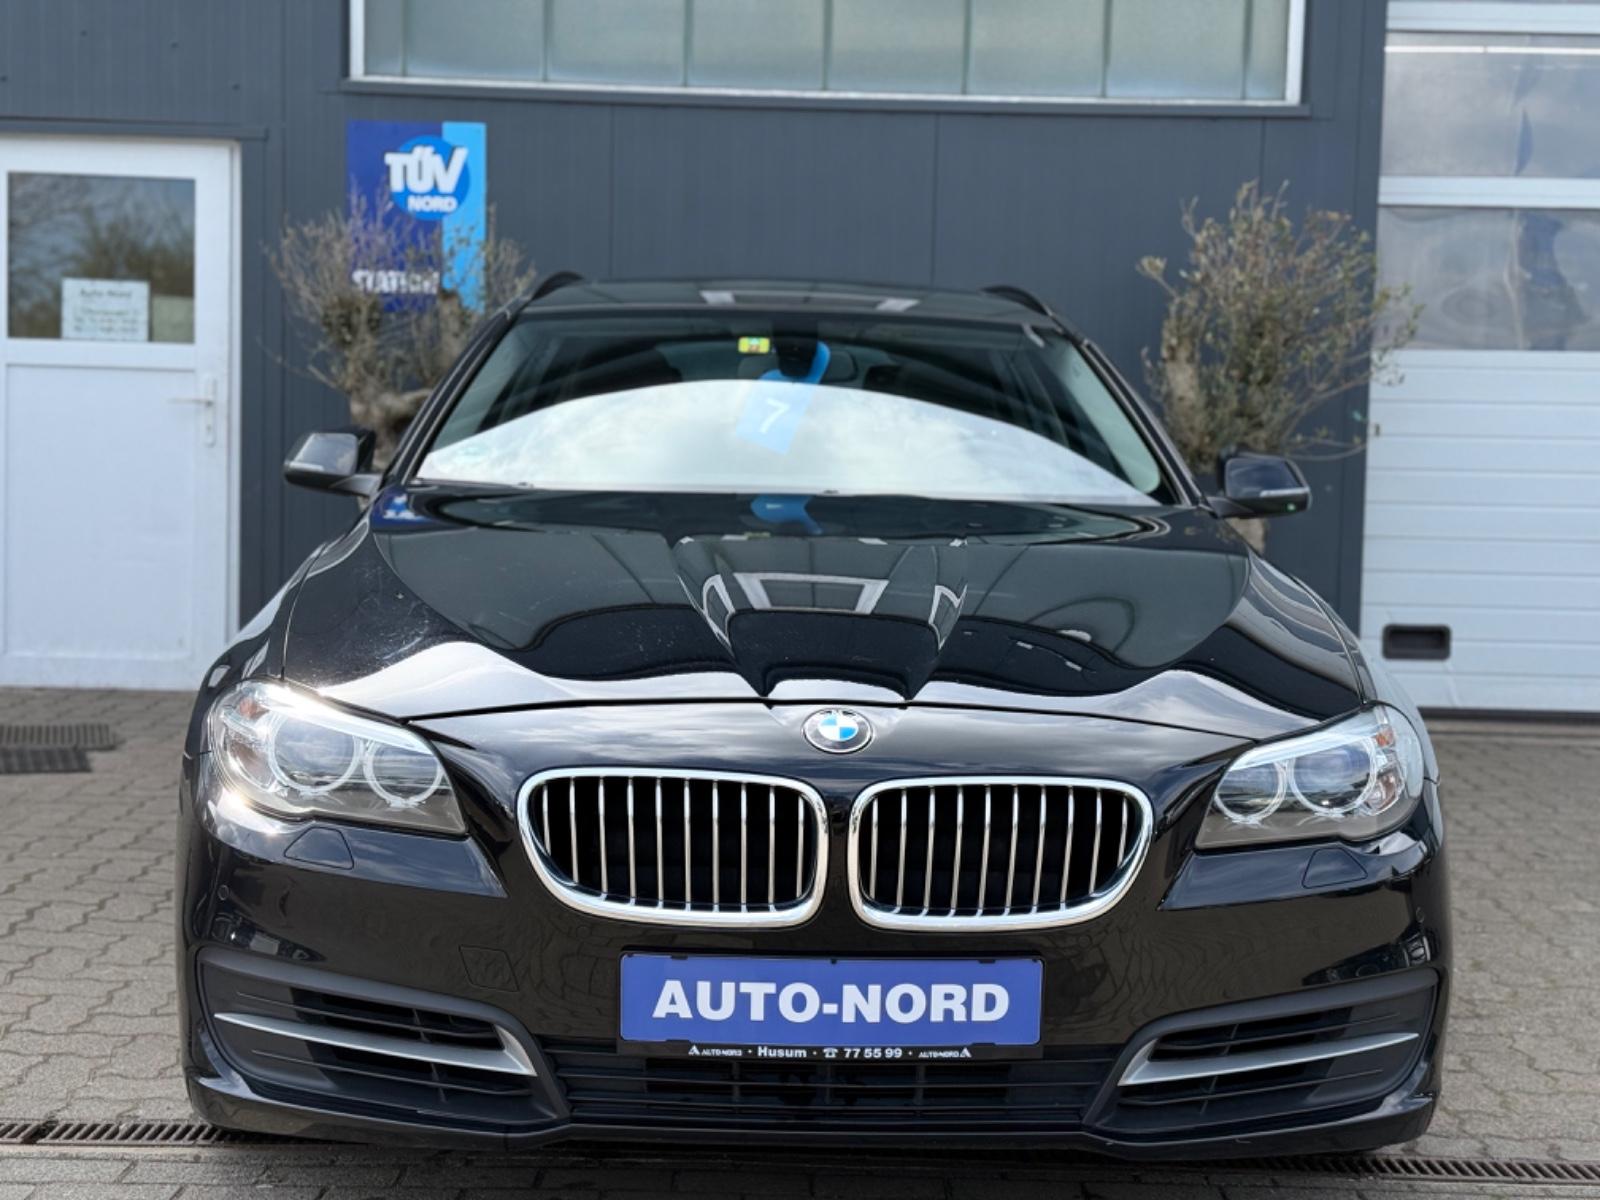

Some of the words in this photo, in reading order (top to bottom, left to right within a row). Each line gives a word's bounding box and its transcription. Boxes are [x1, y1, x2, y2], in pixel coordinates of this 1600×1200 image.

[384, 145, 469, 193] TÜV
[407, 195, 458, 212] NORD
[760, 397, 790, 434] 7
[652, 979, 1010, 1023] AUTO-NORD
[758, 1046, 807, 1058] Husum
